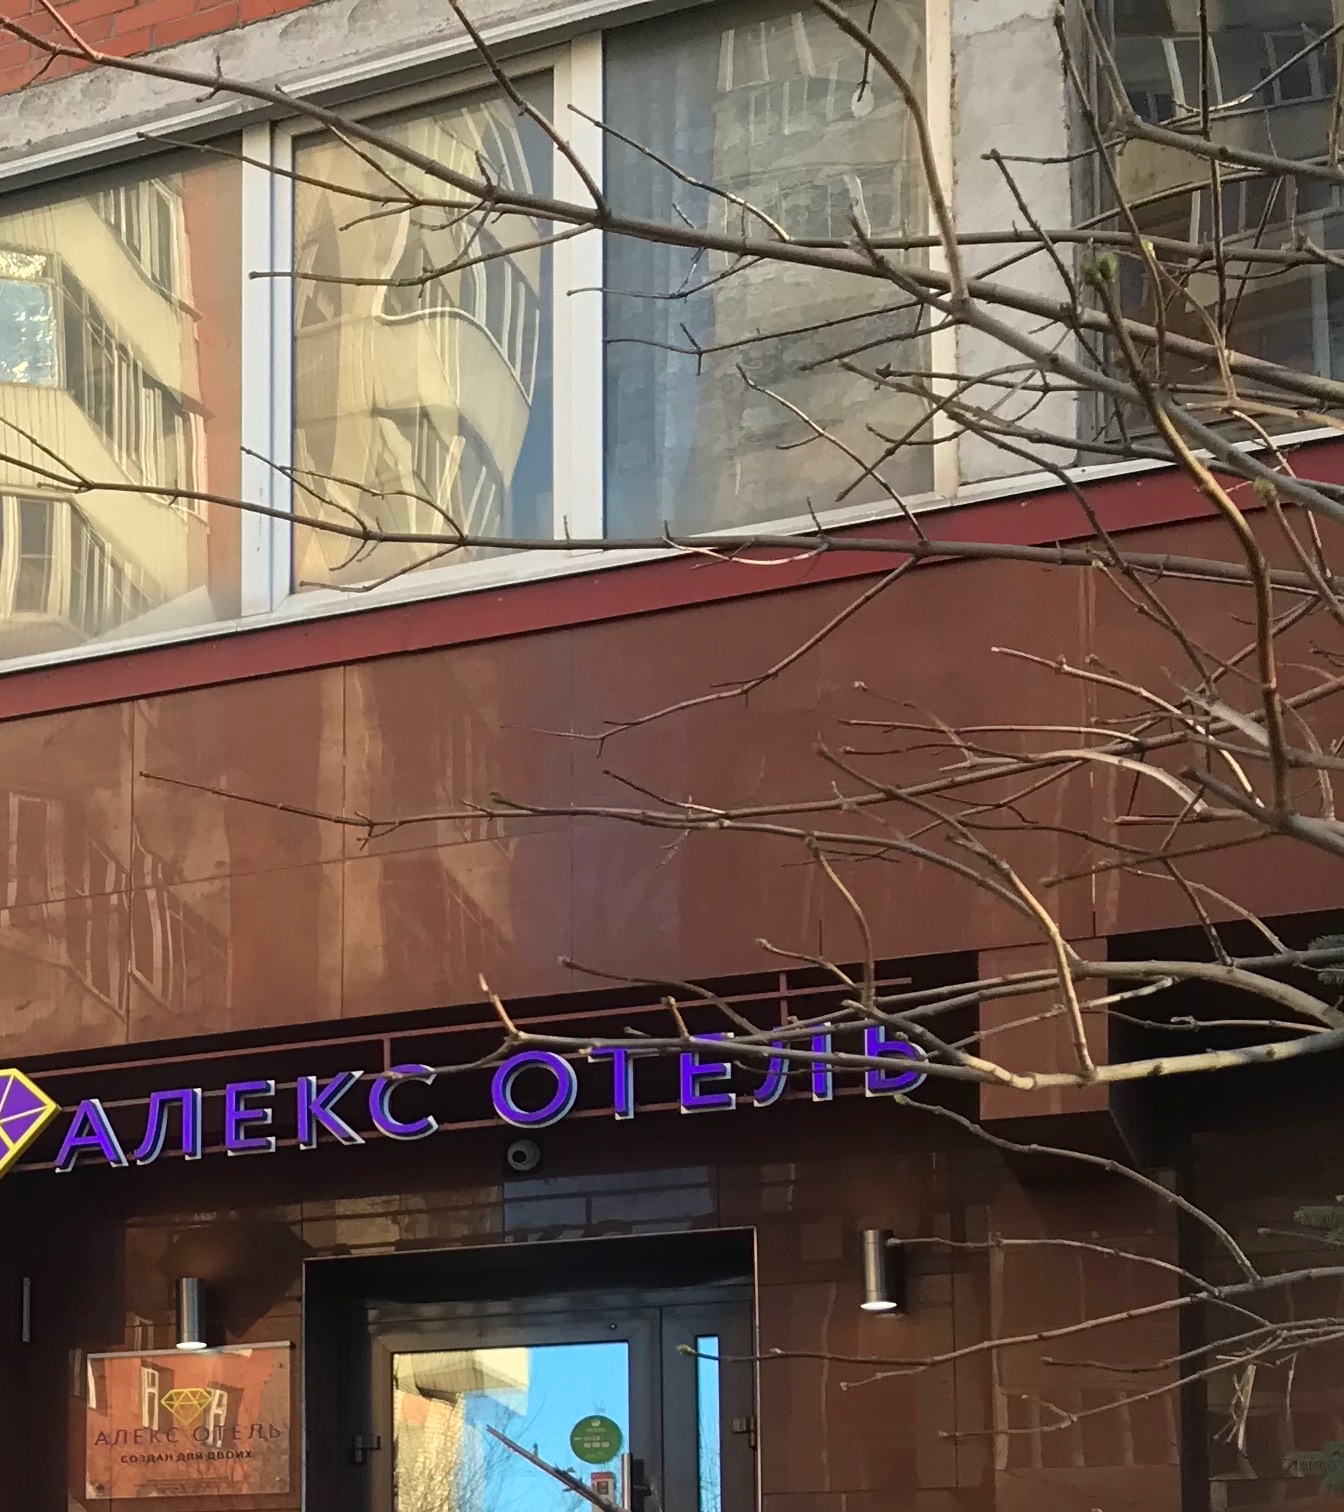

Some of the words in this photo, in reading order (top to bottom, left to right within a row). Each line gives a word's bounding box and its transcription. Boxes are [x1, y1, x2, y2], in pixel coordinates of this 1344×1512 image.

[55, 1063, 439, 1173] АЛЕКС
[491, 1023, 929, 1129] ОТЕЛЬ
[94, 1427, 180, 1446] АЛЕКС
[192, 1423, 282, 1442] ОТЕЛЬ
